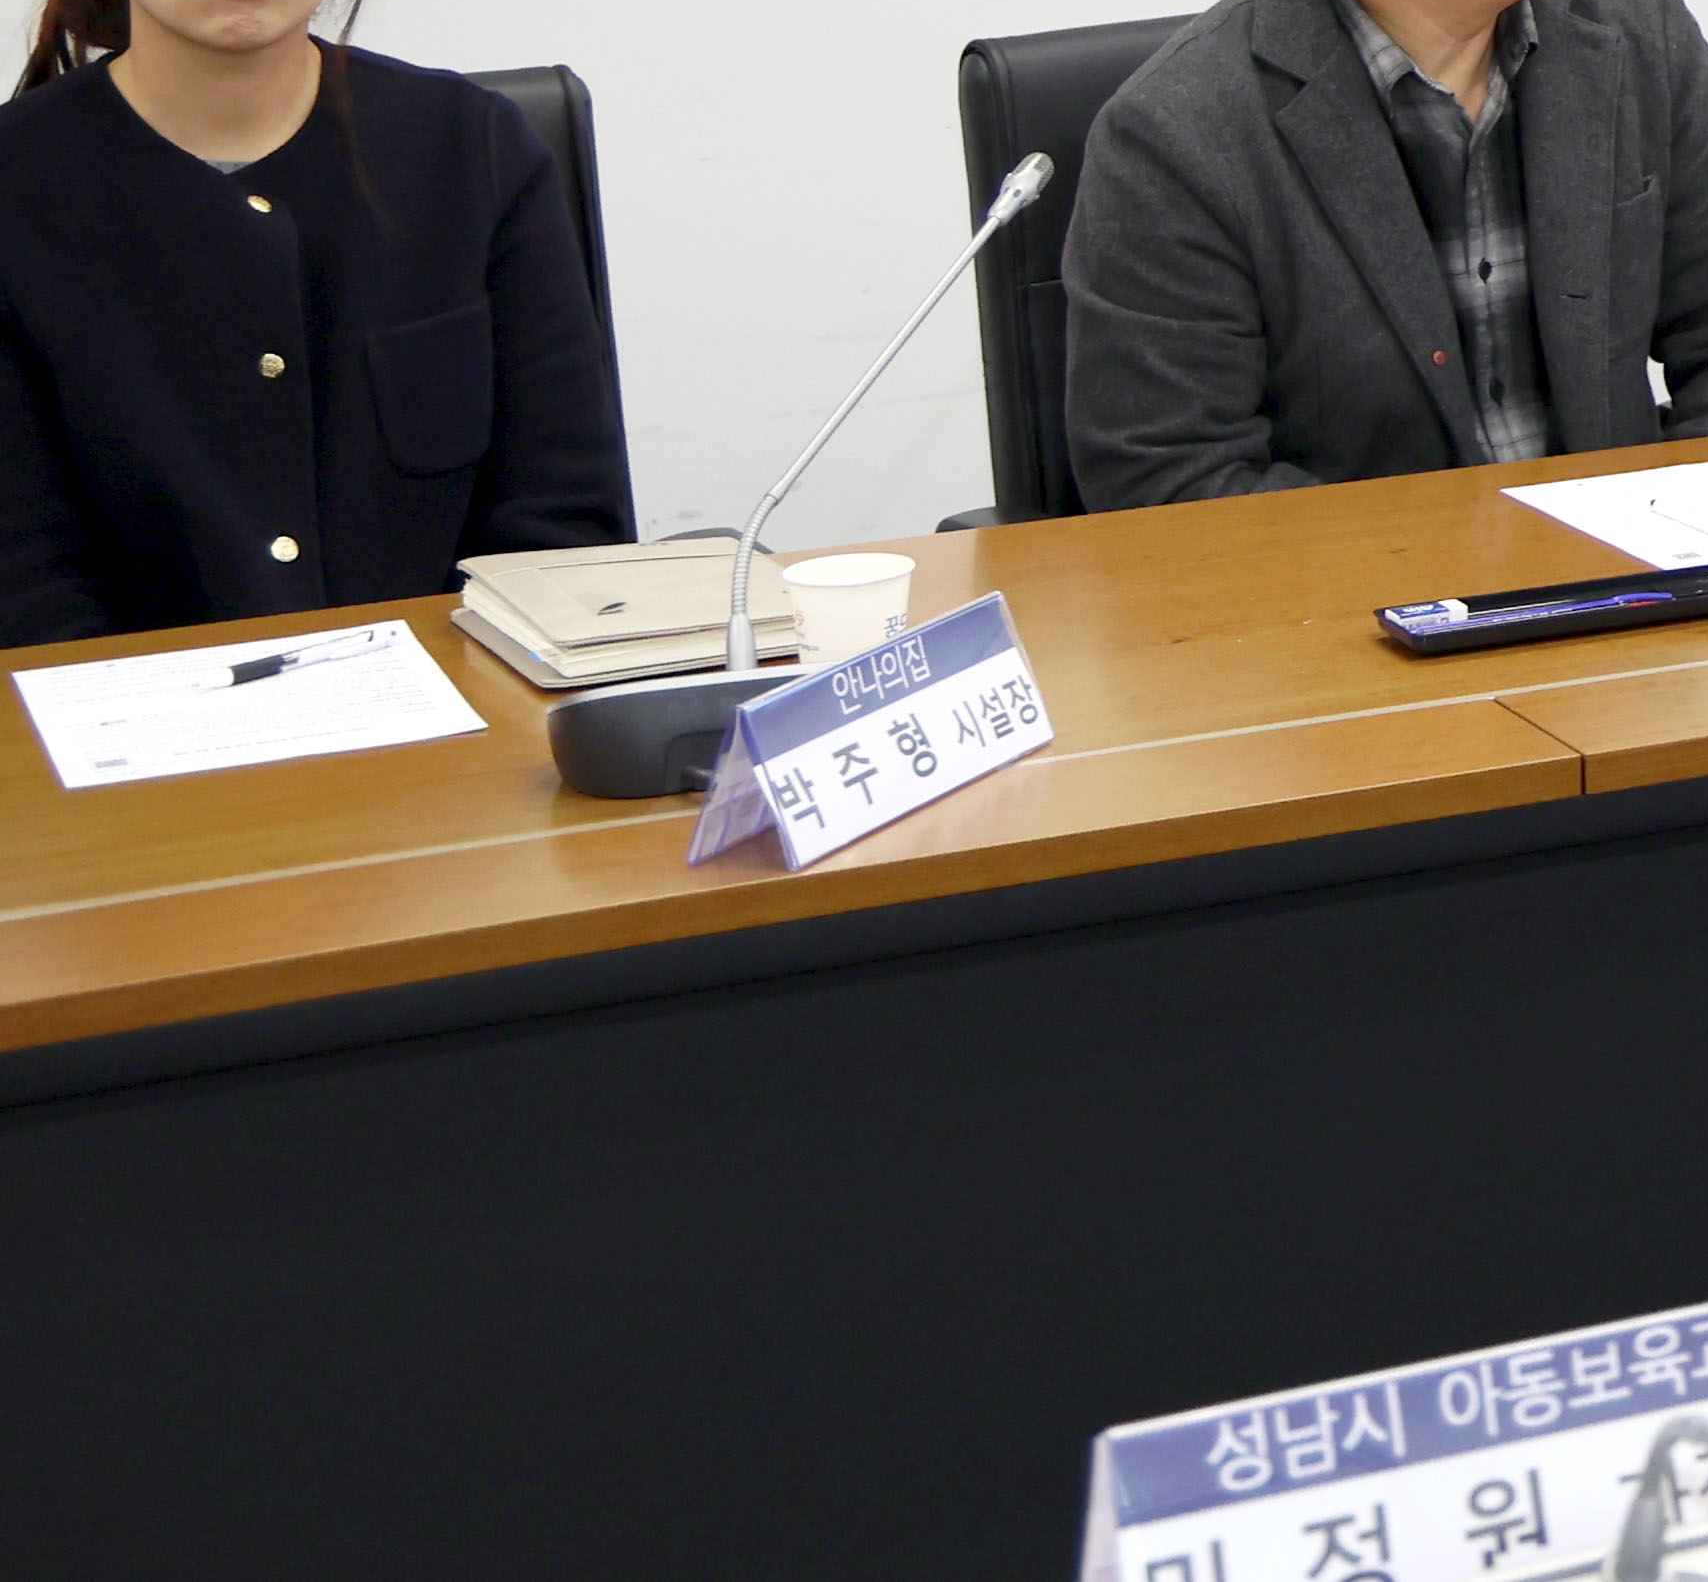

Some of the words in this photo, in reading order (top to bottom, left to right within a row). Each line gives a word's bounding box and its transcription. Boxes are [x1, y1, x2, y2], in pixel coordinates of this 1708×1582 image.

[831, 634, 932, 715] 안나의집
[950, 674, 1040, 749] 시설장
[1204, 1382, 1407, 1493] 성남시
